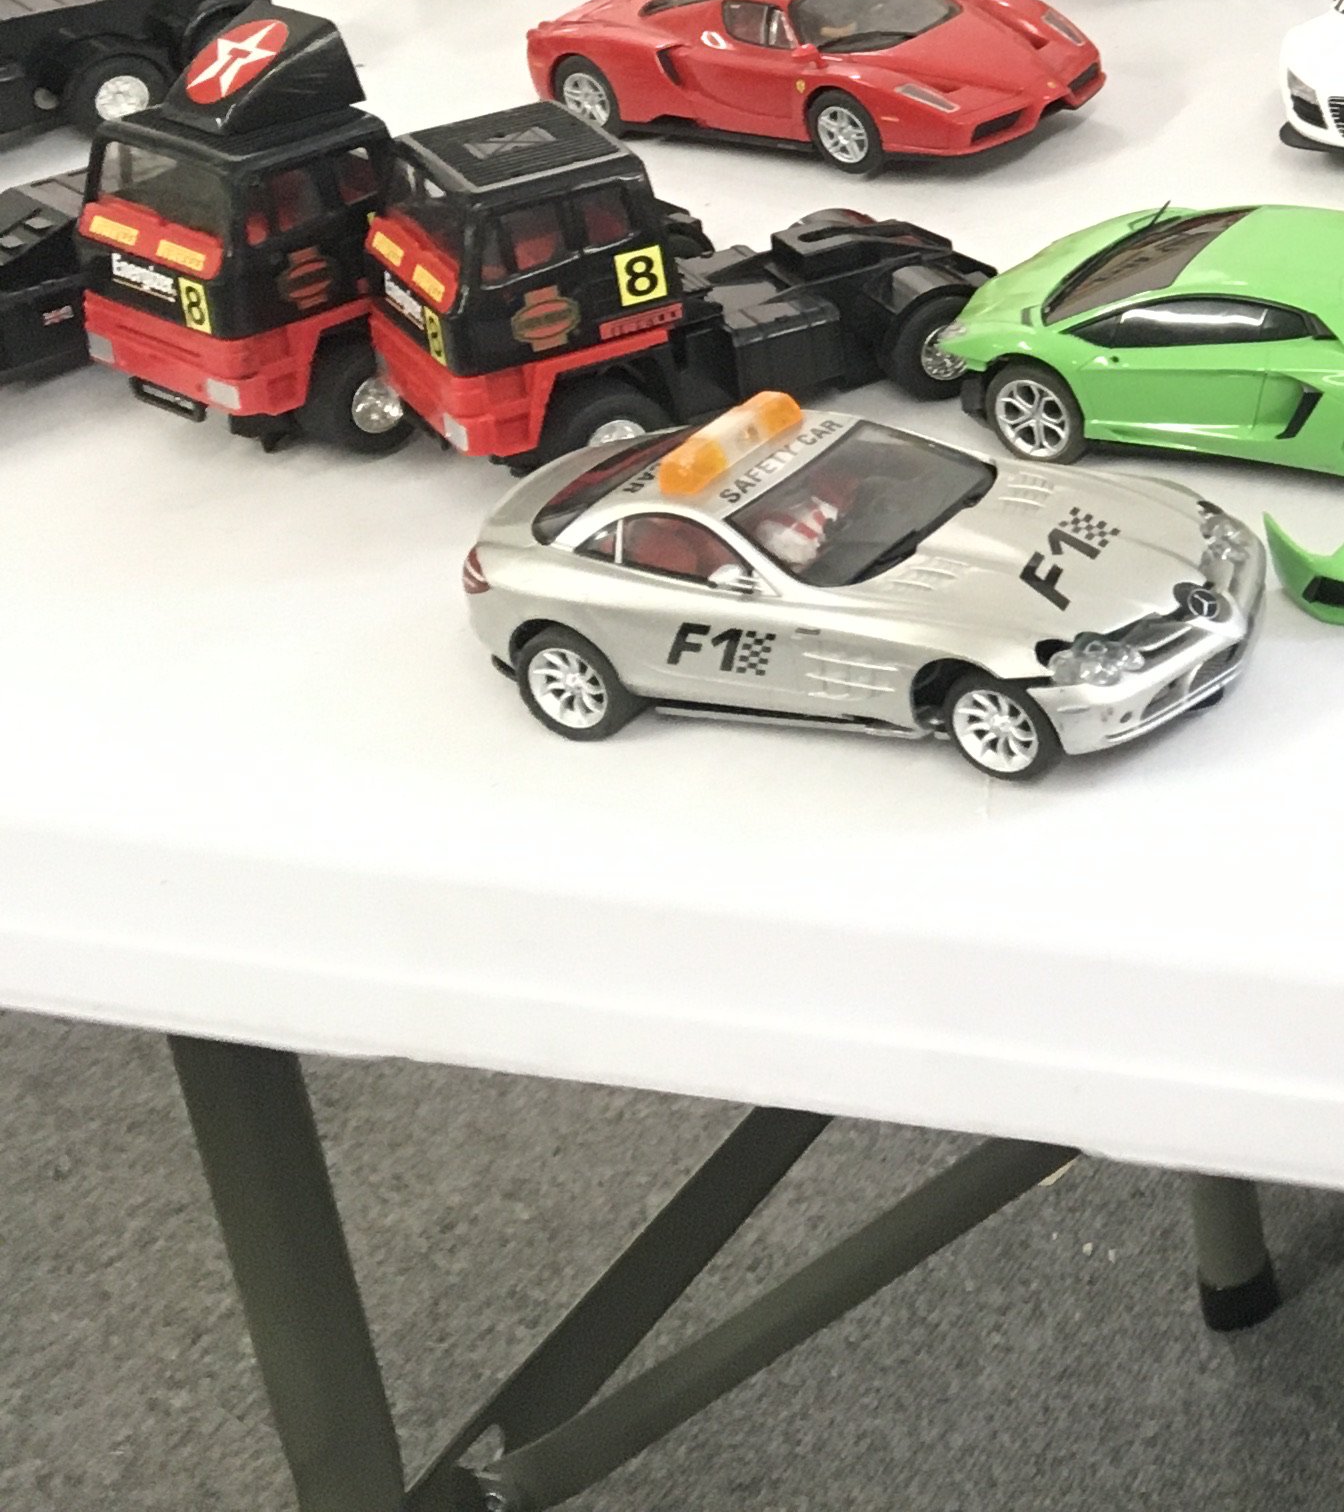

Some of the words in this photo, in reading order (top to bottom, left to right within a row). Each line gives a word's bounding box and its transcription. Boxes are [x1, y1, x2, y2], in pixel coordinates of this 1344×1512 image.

[625, 254, 659, 298] 8
[184, 285, 206, 327] 8
[719, 443, 800, 504] SAFETY
[796, 419, 845, 456] CAR
[1019, 526, 1103, 612] F1
[666, 621, 745, 672] F1
